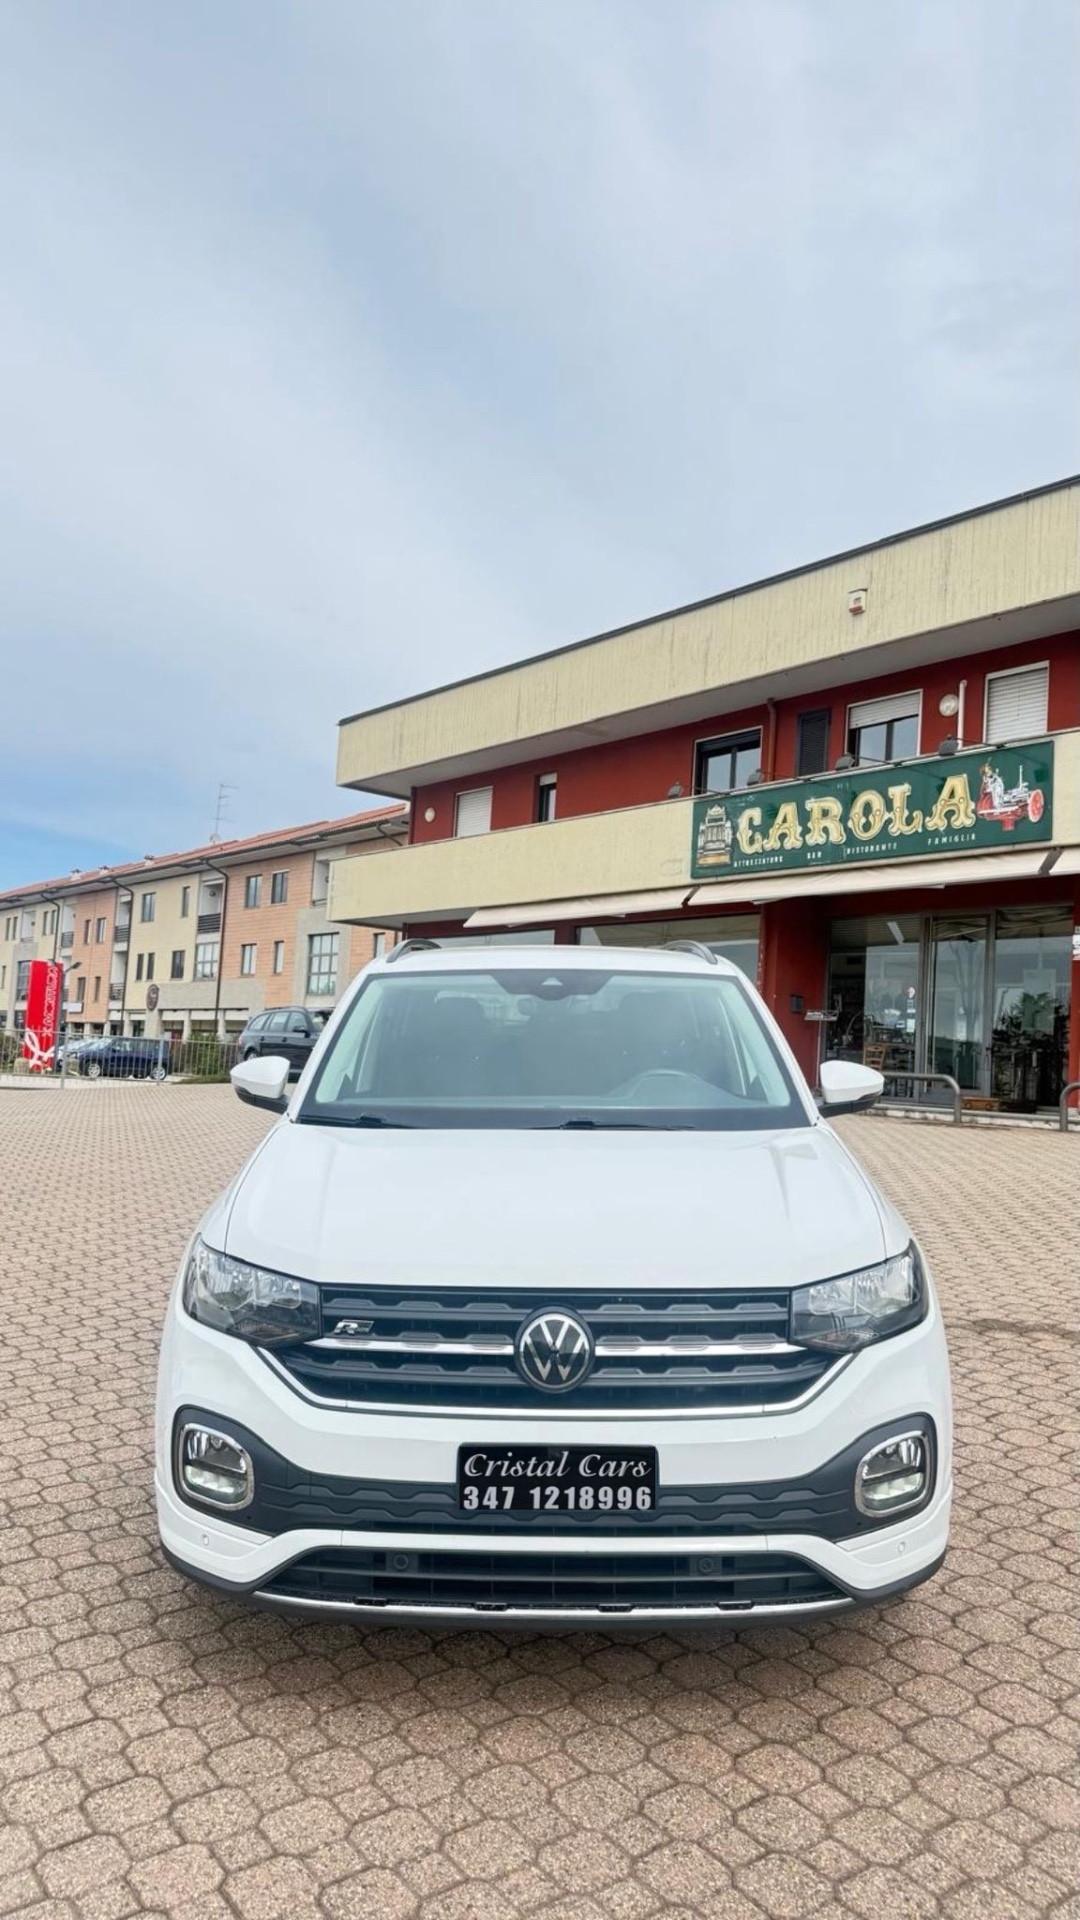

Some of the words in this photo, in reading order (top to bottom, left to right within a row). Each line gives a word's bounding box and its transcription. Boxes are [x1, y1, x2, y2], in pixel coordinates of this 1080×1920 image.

[736, 773, 977, 854] CAROLA
[807, 851, 823, 860] BAR
[846, 843, 898, 855] RISTORANTE
[927, 833, 976, 846] FAMIGLIA
[463, 1450, 570, 1478] Cristal
[578, 1453, 653, 1478] Cars
[463, 1485, 516, 1510] 347
[529, 1485, 652, 1510] 1218996
